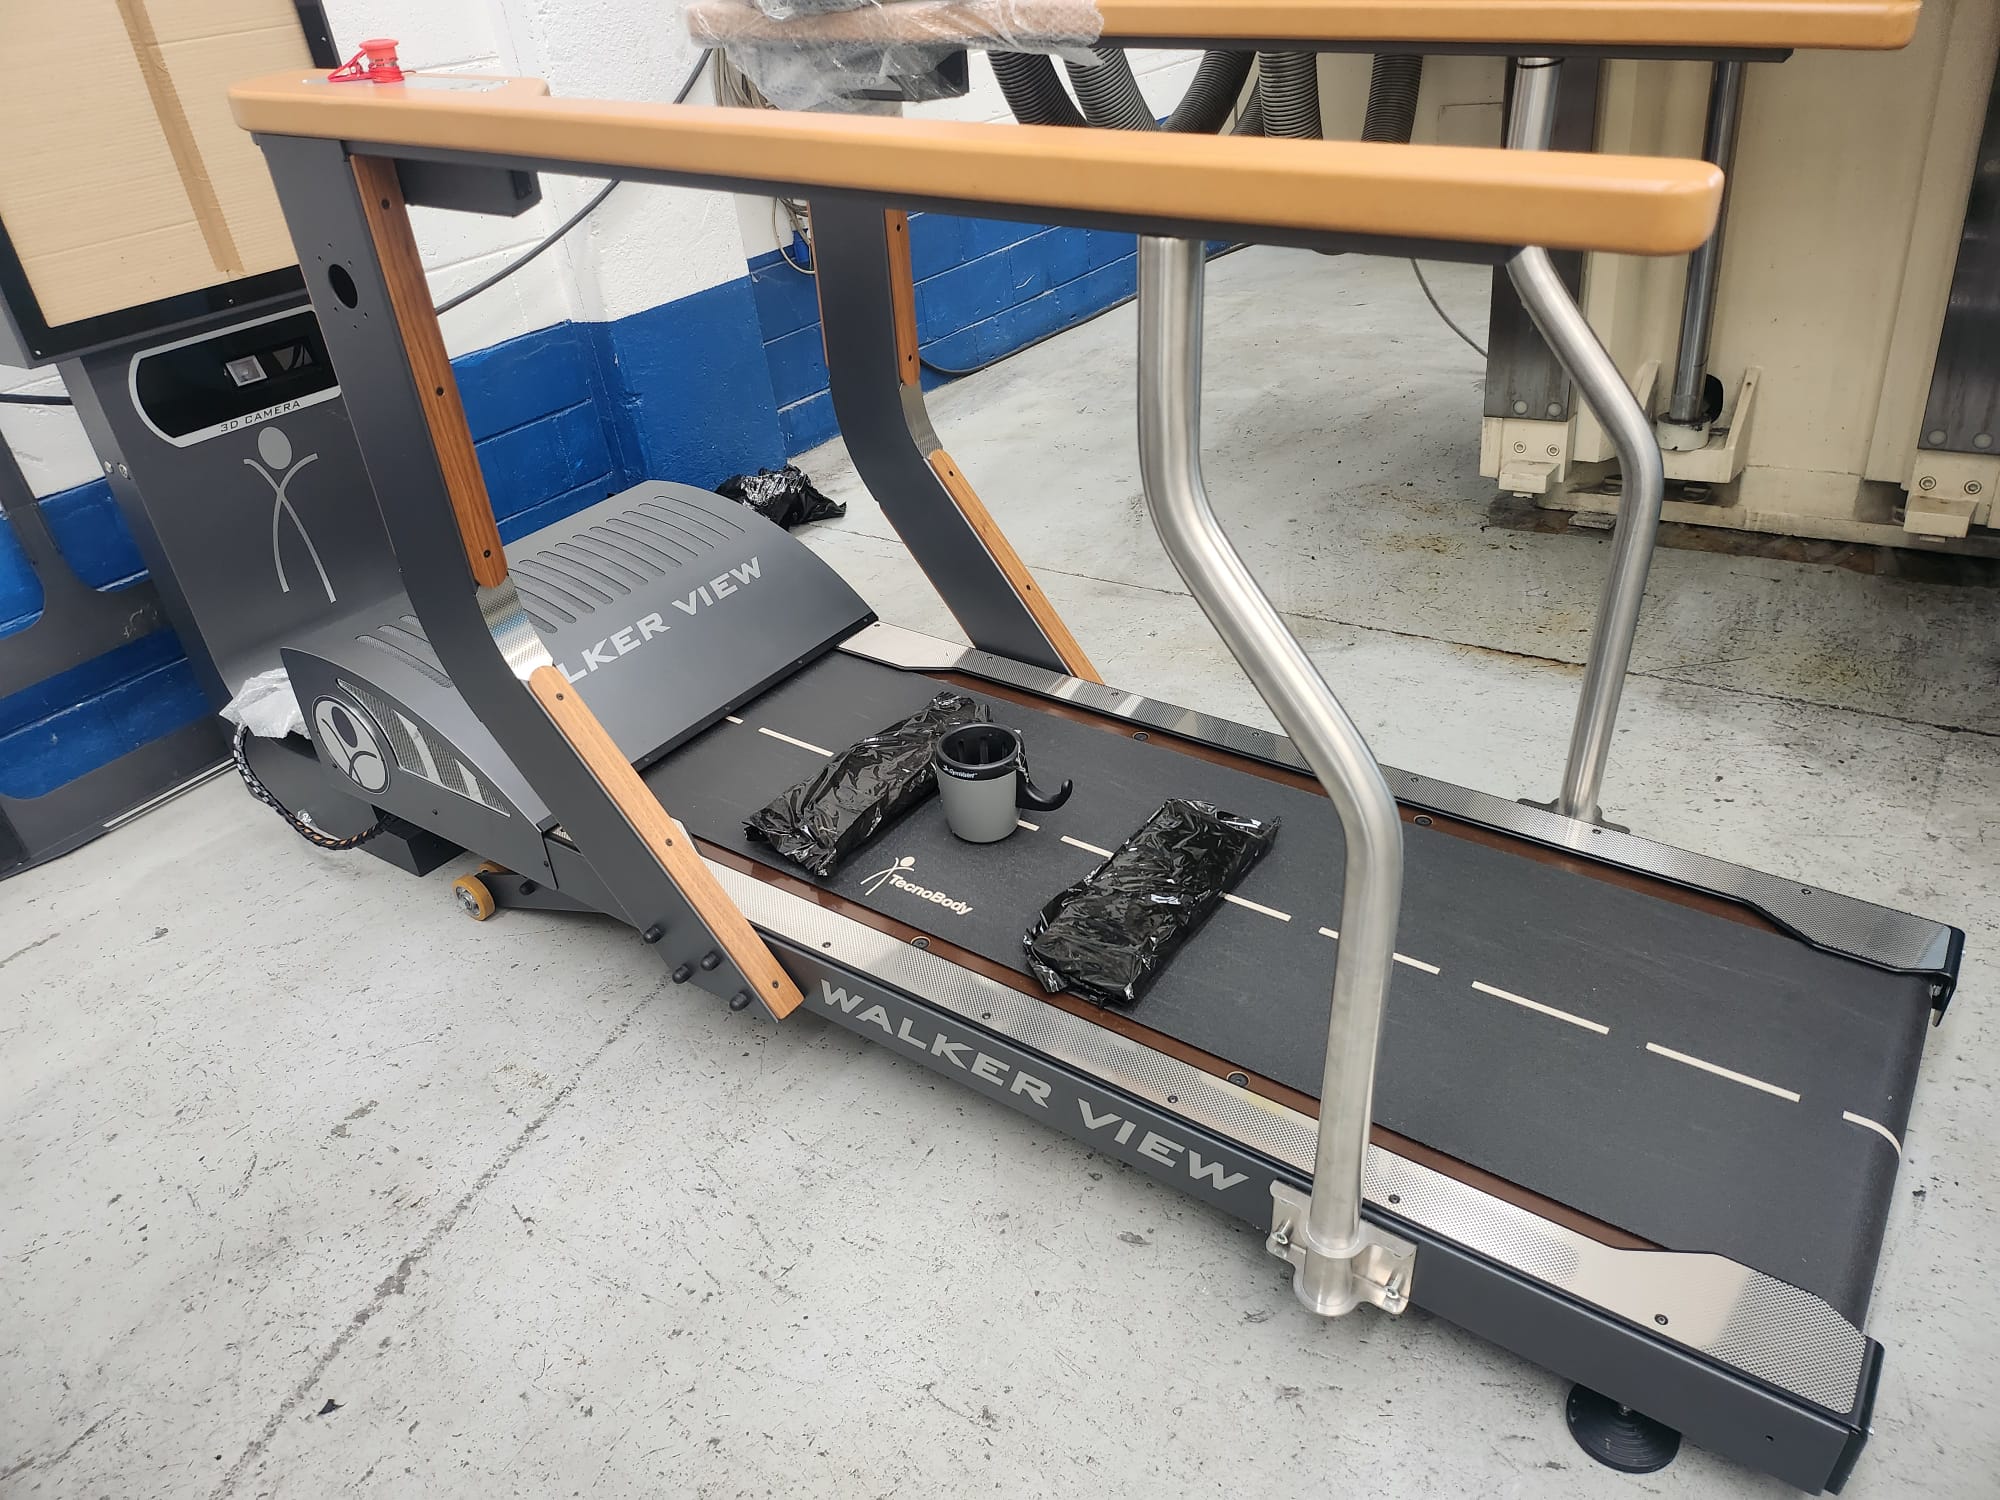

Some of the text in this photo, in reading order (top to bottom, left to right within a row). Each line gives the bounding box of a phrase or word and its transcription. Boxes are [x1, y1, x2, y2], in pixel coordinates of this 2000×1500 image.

[220, 400, 301, 433] 3D CAMERA
[556, 556, 762, 684] LKER VIEW
[888, 873, 974, 916] TecnoBody
[820, 978, 1250, 1191] WALKER VIEW
